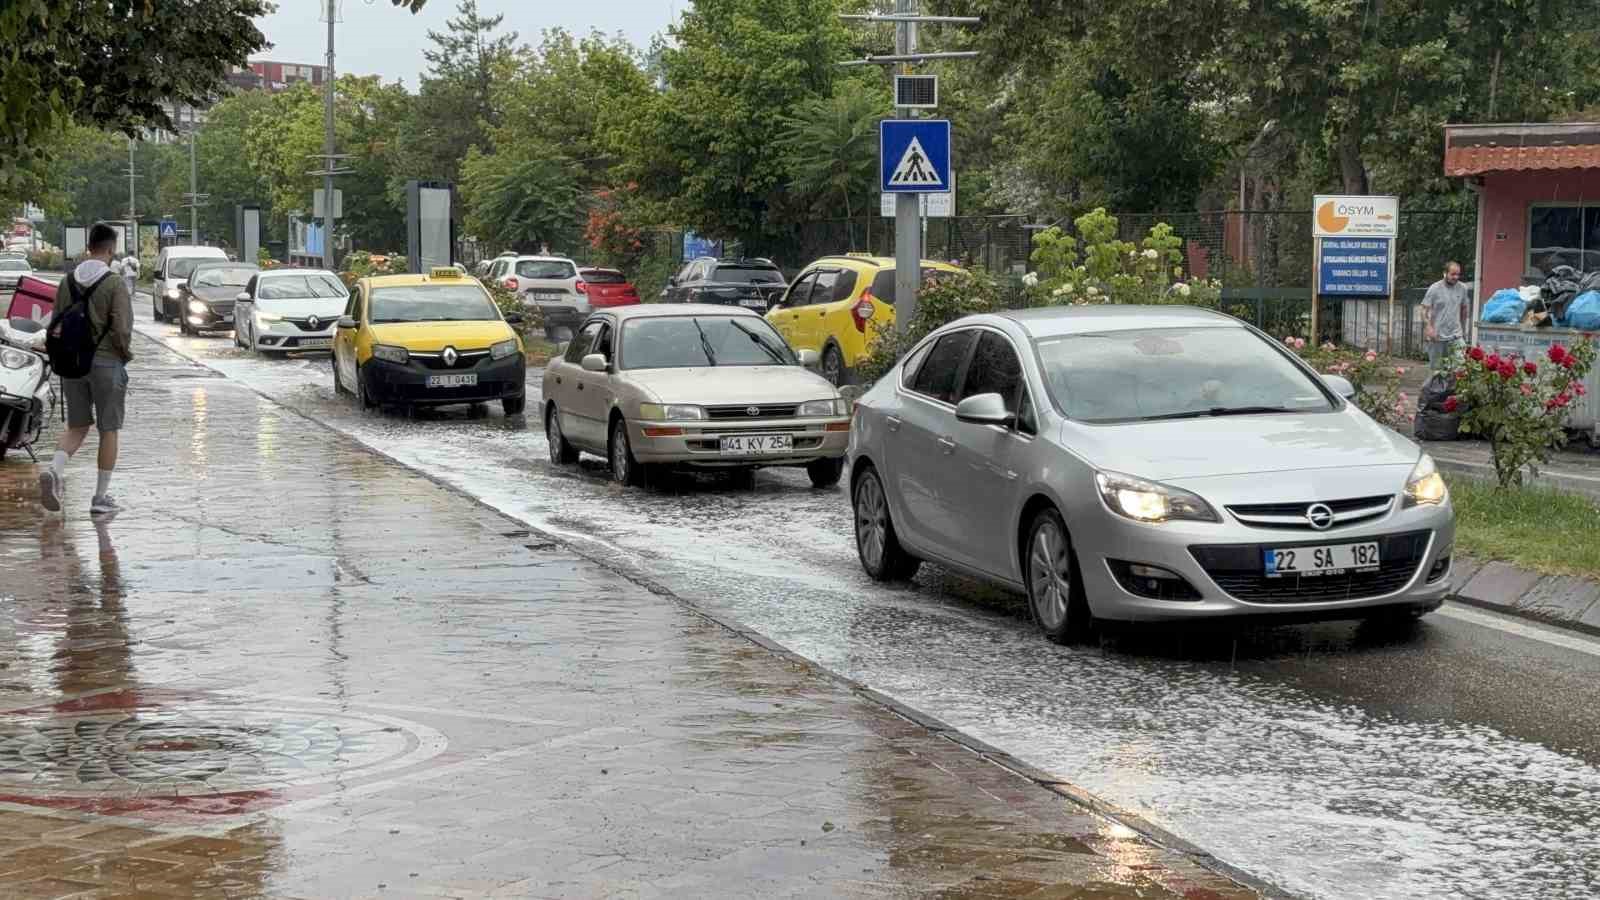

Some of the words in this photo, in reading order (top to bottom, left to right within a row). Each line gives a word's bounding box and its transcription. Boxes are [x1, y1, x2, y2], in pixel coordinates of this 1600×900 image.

[1338, 205, 1374, 215] ÖSYM
[728, 439, 742, 450] 41
[747, 437, 765, 450] KY
[769, 436, 791, 449] 254
[1275, 550, 1297, 571] 22
[1313, 548, 1334, 568] SA
[1351, 544, 1377, 565] 182
